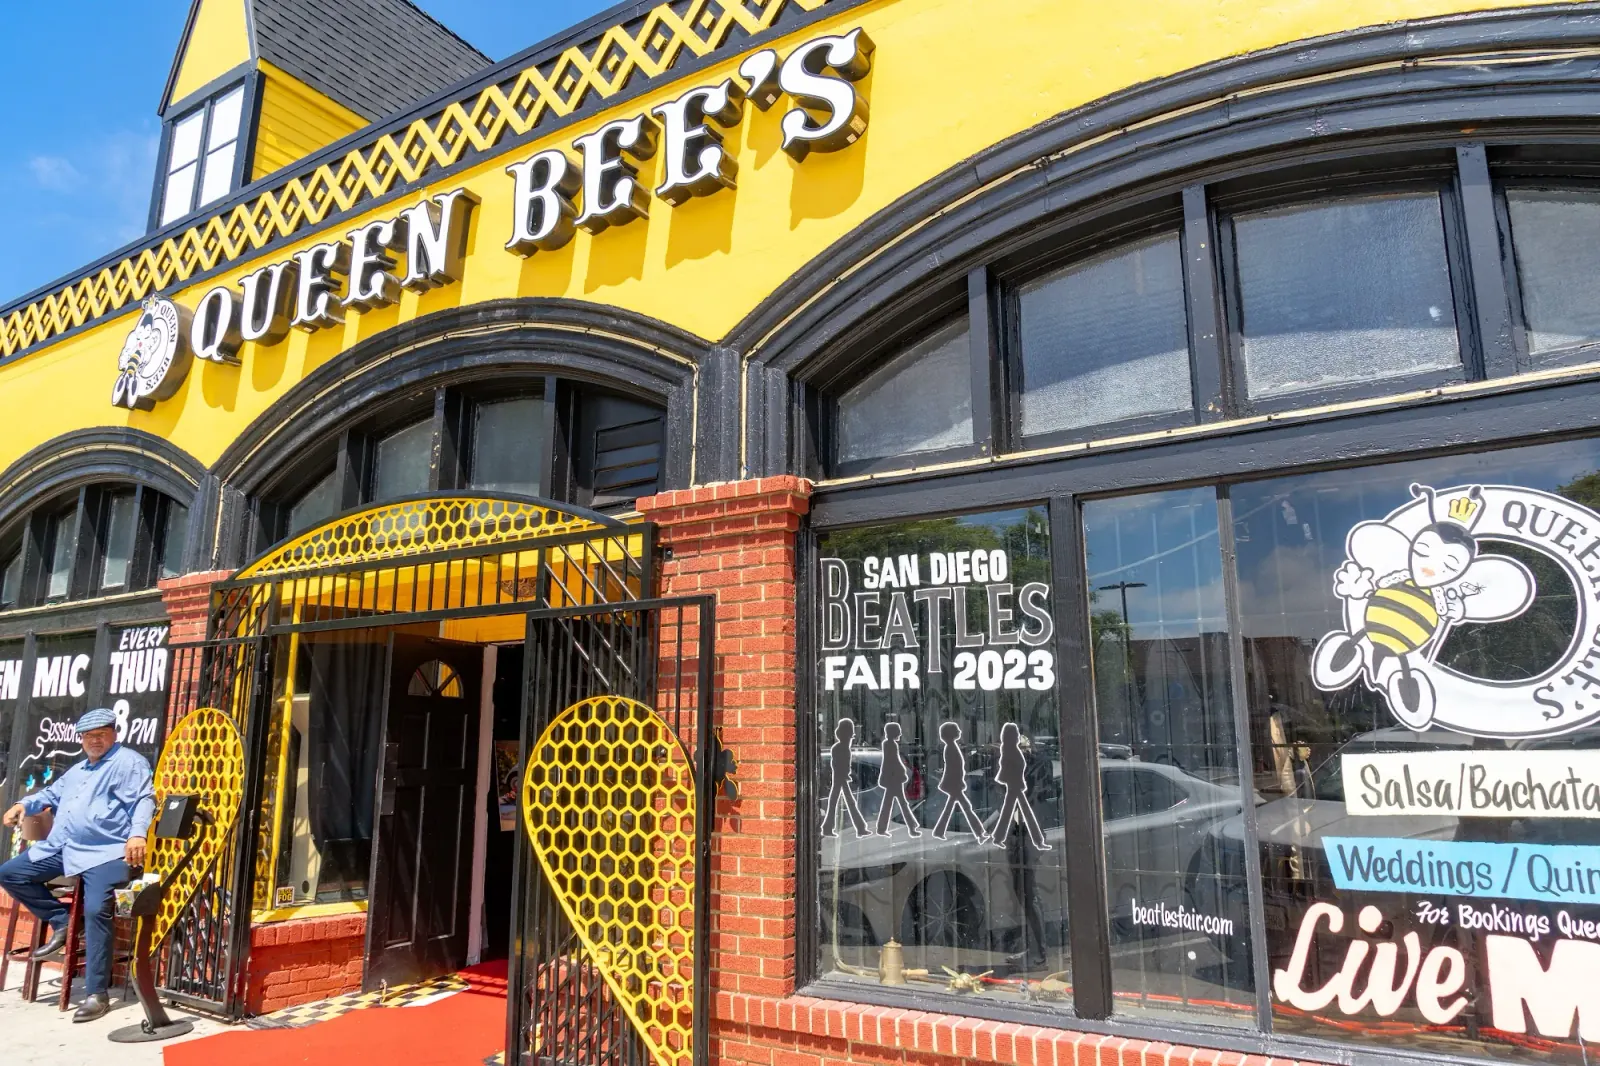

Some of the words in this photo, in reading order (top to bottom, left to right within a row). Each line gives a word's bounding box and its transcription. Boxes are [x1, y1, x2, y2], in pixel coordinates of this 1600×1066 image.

[190, 187, 466, 362] QUEEN
[505, 26, 863, 252] BEE'S
[160, 304, 177, 343] QUEEN
[863, 556, 921, 589] SAN
[929, 549, 1008, 586] DIEGO
[820, 557, 1054, 674] BEATLES
[119, 627, 169, 651] EVERY
[32, 653, 91, 698] MIC
[109, 648, 169, 694] THUR
[824, 652, 921, 691] FAIR
[953, 649, 1056, 691] 2023
[112, 699, 130, 744] 8
[127, 718, 158, 745] PM
[1336, 844, 1492, 894] Weddings
[1131, 898, 1234, 935] beatlesfair.com
[1458, 904, 1550, 941] Bookings
[1273, 902, 1468, 1024] Live
